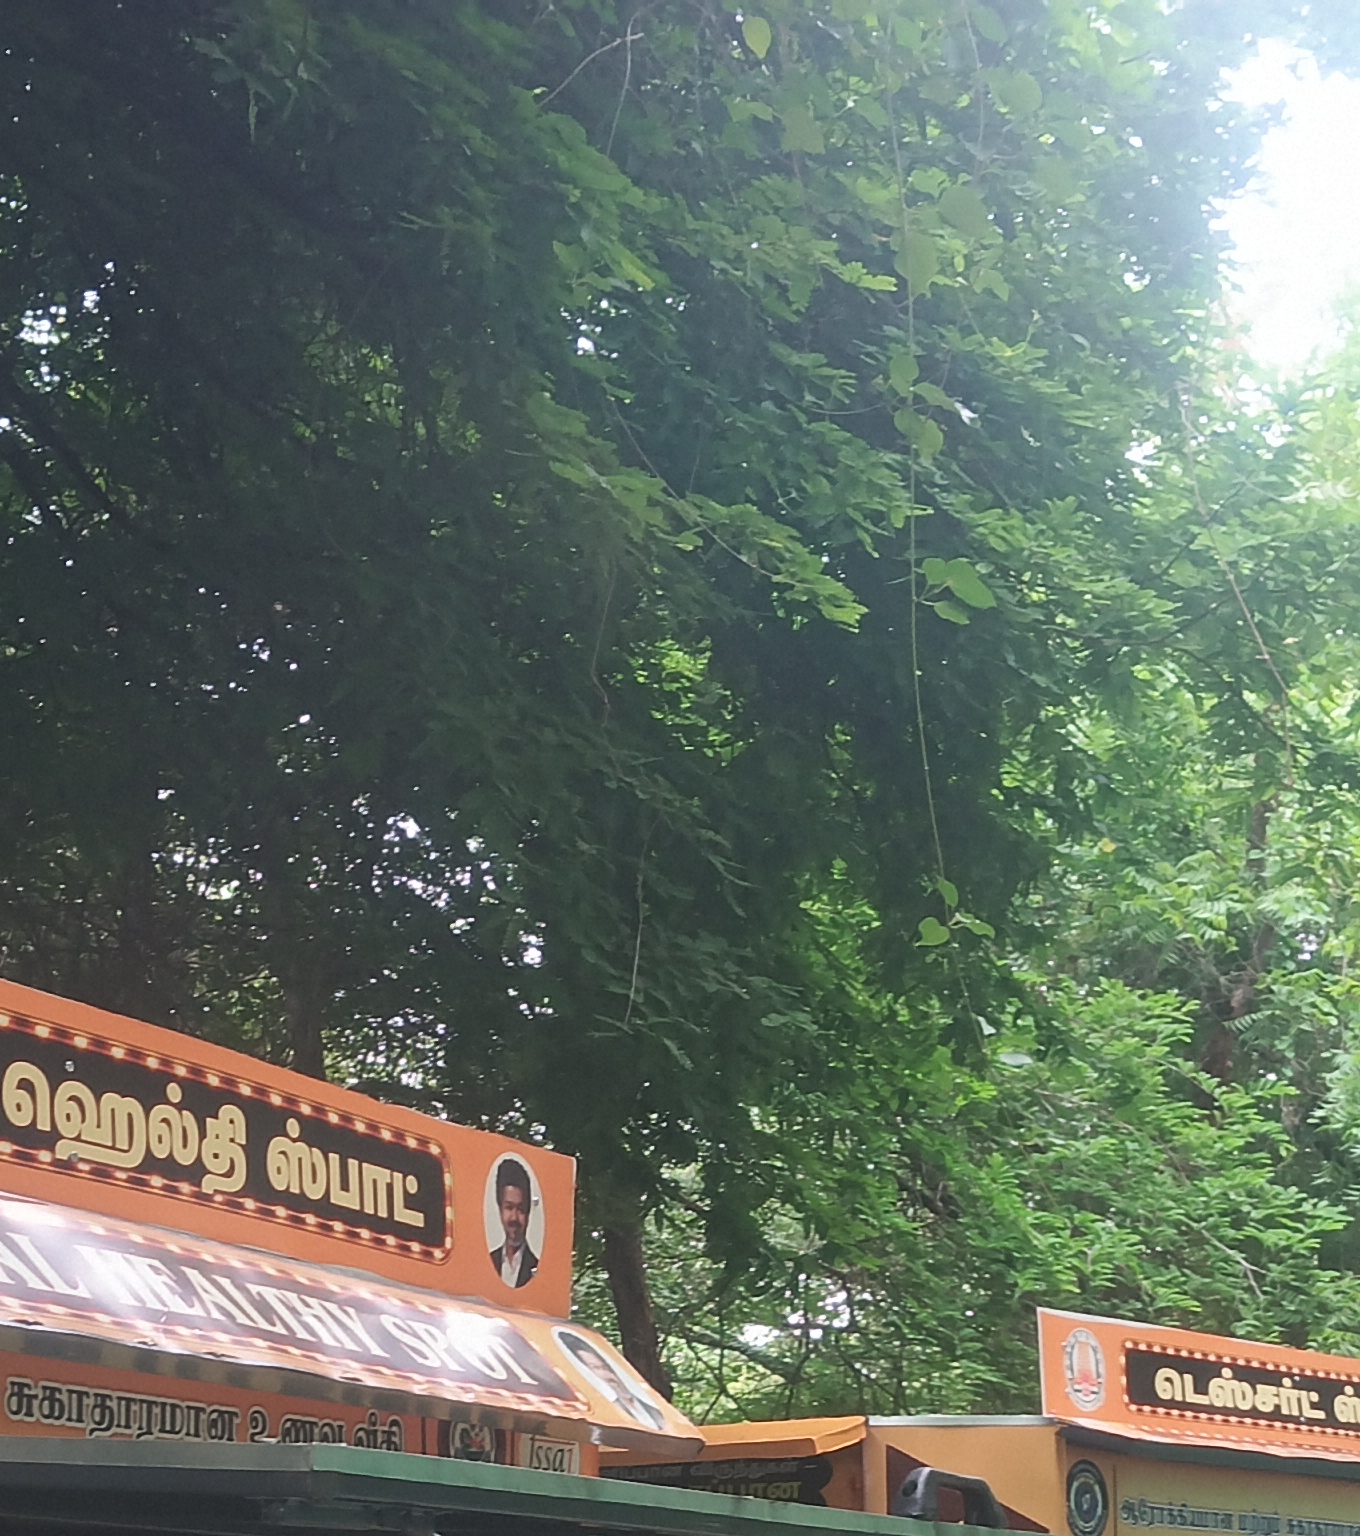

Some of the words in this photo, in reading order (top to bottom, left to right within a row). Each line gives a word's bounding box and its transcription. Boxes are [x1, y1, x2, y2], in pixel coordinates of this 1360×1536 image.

[2, 1061, 248, 1195] ஹெல்தி
[267, 1118, 425, 1228] ஸ்பாட்
[75, 1241, 390, 1359] HEALTHY
[380, 1311, 539, 1386] SPOT
[7, 1375, 240, 1442] சுகாதாரமான
[1154, 1367, 1326, 1420] டெஸ்சர்ட்
